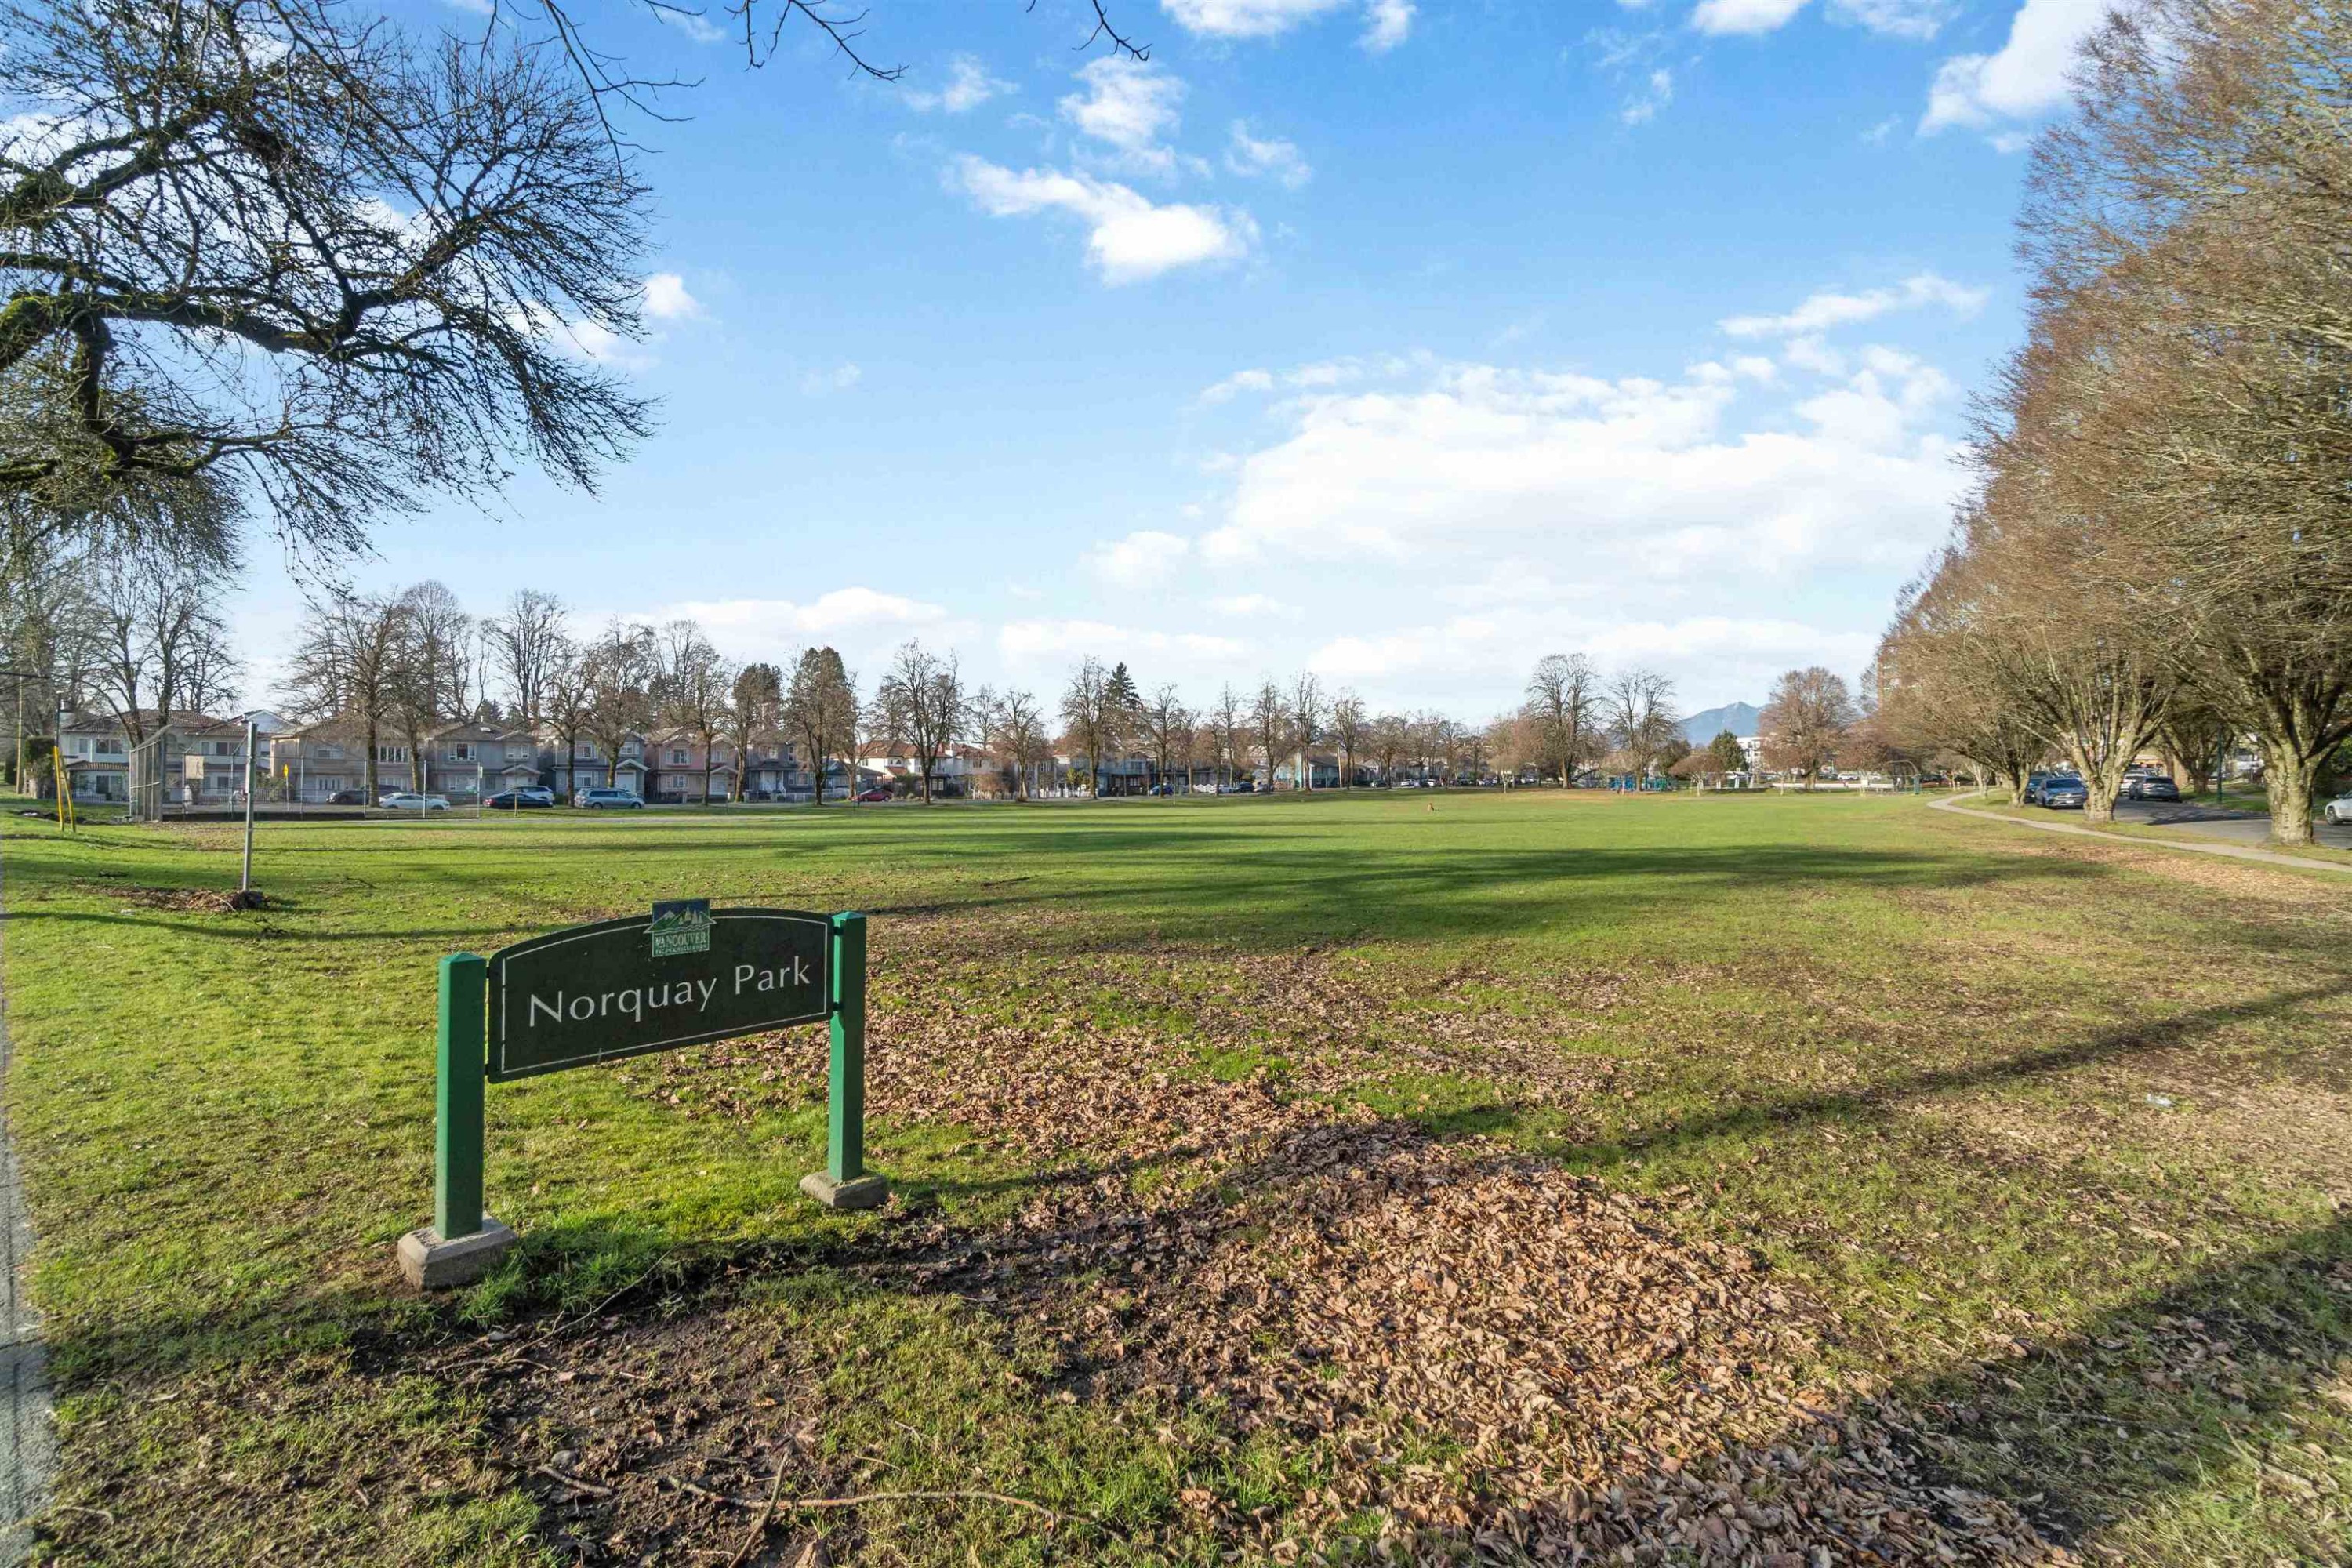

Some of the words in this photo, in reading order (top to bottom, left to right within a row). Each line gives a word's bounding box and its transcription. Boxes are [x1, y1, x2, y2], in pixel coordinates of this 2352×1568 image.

[655, 931, 706, 948] VANCOUVER
[528, 977, 717, 1027] Norquay
[735, 955, 811, 995] Park
